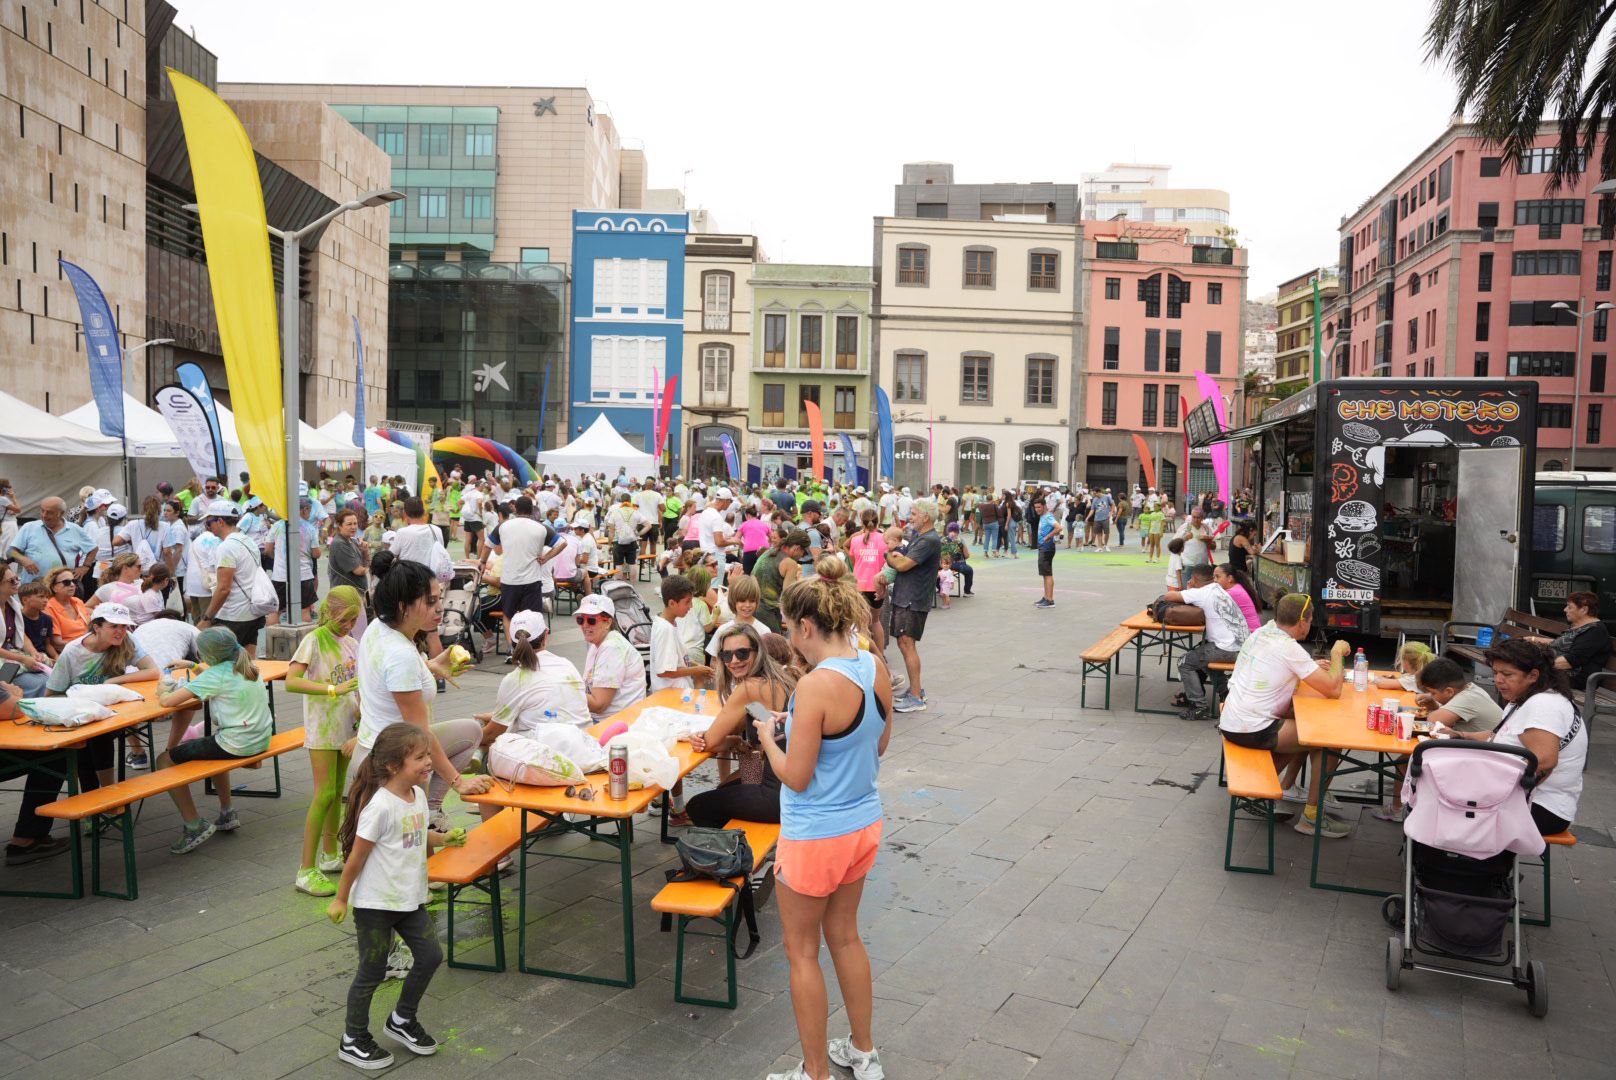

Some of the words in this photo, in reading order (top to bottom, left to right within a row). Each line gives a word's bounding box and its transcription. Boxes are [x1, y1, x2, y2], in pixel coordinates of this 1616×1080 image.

[1338, 400, 1396, 420] CHE
[1399, 400, 1520, 421] MOTERO
[777, 440, 836, 450] UNIFORAS
[894, 451, 925, 460] efties
[958, 451, 991, 460] lefties
[1022, 452, 1055, 462] lefties
[1328, 590, 1334, 598] B
[1336, 590, 1357, 598] 6641
[1360, 591, 1372, 599] VC
